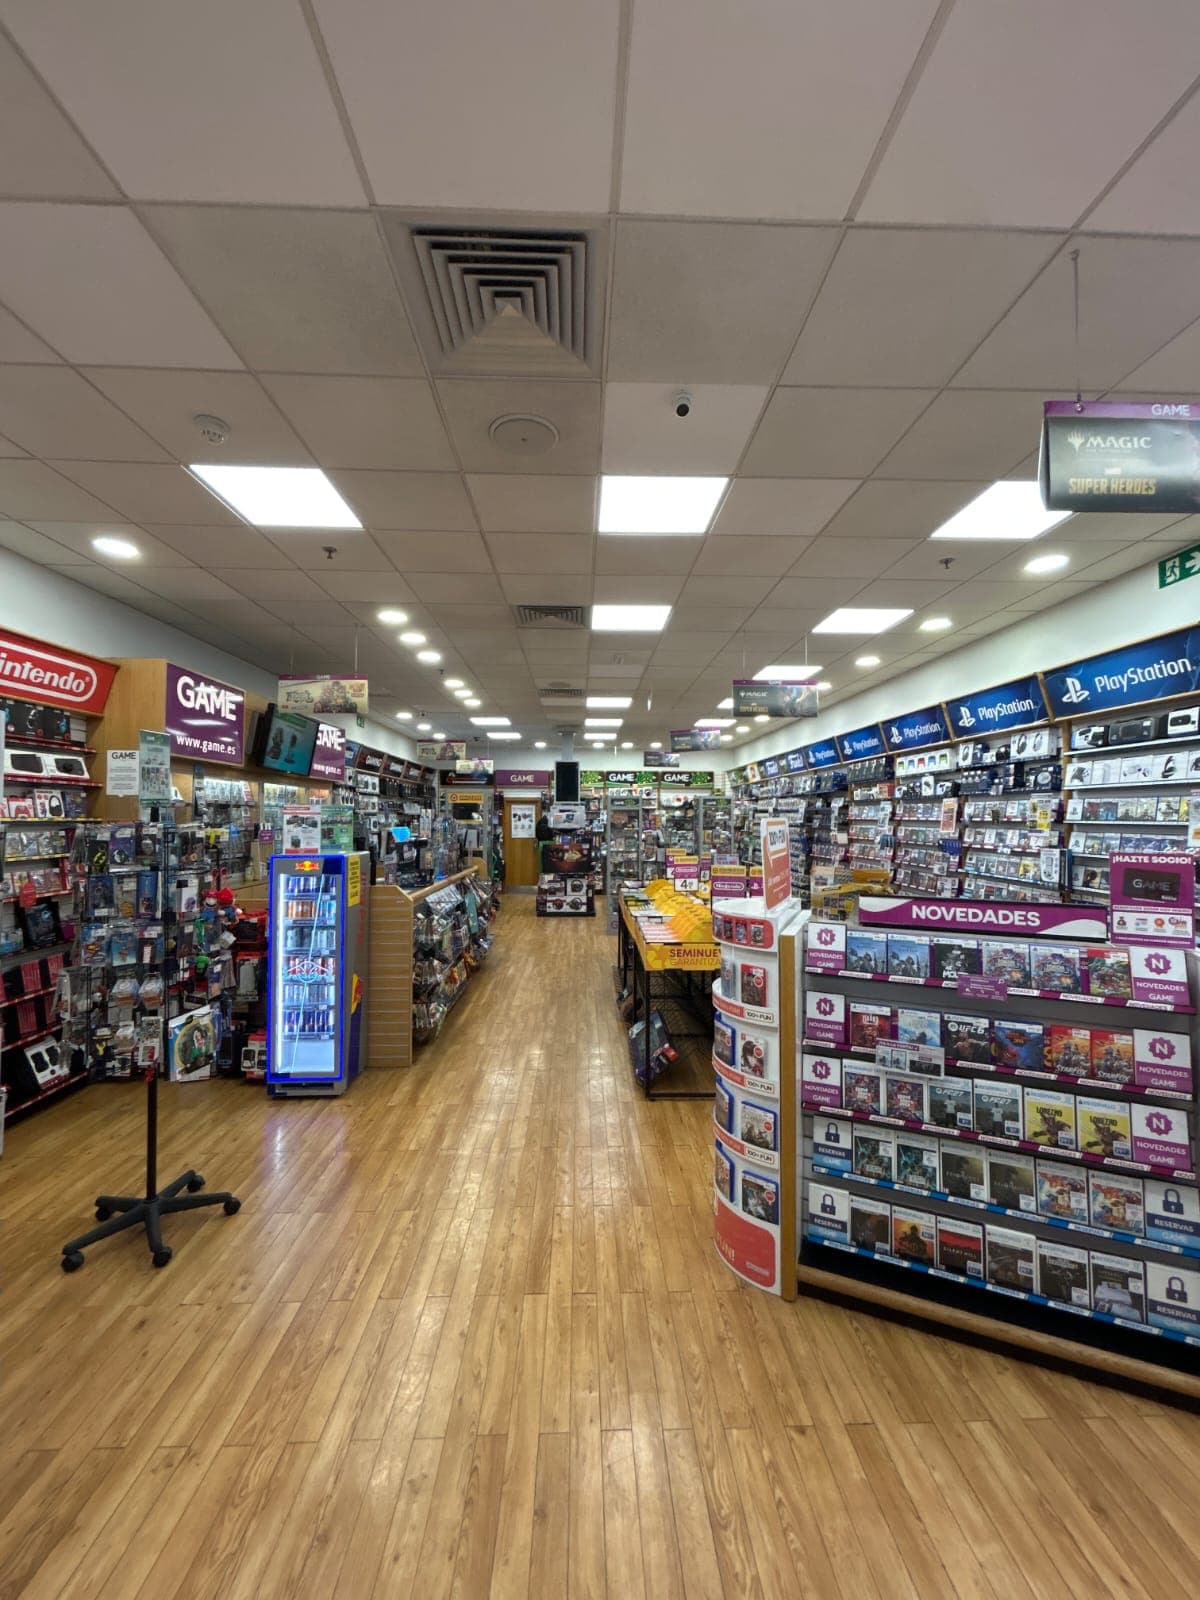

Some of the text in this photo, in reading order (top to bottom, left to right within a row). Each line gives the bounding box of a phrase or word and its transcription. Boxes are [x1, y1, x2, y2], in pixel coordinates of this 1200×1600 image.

[1151, 404, 1191, 416] GAME
[1086, 436, 1153, 449] MAGIC
[1069, 478, 1157, 495] SUPER HEROES
[1094, 657, 1192, 693] PlayStation
[176, 675, 239, 721] GAME
[978, 698, 1035, 721] PlayStation
[903, 723, 941, 739] PlayStation
[176, 735, 237, 756] www.game.es
[852, 736, 879, 751] PlayStation
[111, 751, 137, 760] GAME
[510, 774, 535, 783] GAME
[608, 773, 635, 782] GAME
[663, 773, 690, 782] GAME
[1112, 855, 1192, 865] ¡HAZTE SOCIO!
[1132, 878, 1171, 892] GAME
[911, 904, 1041, 927] NOVEDADES
[669, 949, 722, 958] SEMINUE
[809, 951, 844, 960] NOVEDADES
[1151, 958, 1165, 970] N
[1136, 981, 1185, 993] NOVEDADES
[1148, 993, 1175, 1002] GAME
[808, 1021, 843, 1031] NOVEDADES
[816, 1031, 834, 1039] GAME
[1154, 1043, 1168, 1055] N
[1139, 1065, 1189, 1079] NOVEDADES
[760, 1083, 772, 1092] FUN
[1150, 1078, 1177, 1088] GAME
[804, 1084, 839, 1095] NOVEDADES
[1152, 1117, 1165, 1129] N
[818, 1146, 846, 1158] RESERVAS
[1136, 1141, 1187, 1155] NOVEDADES
[1148, 1155, 1176, 1166] GAME
[813, 1217, 842, 1230] RESERVAS
[1154, 1218, 1195, 1234] RESERVAS
[1156, 1305, 1198, 1322] RESERVAS
